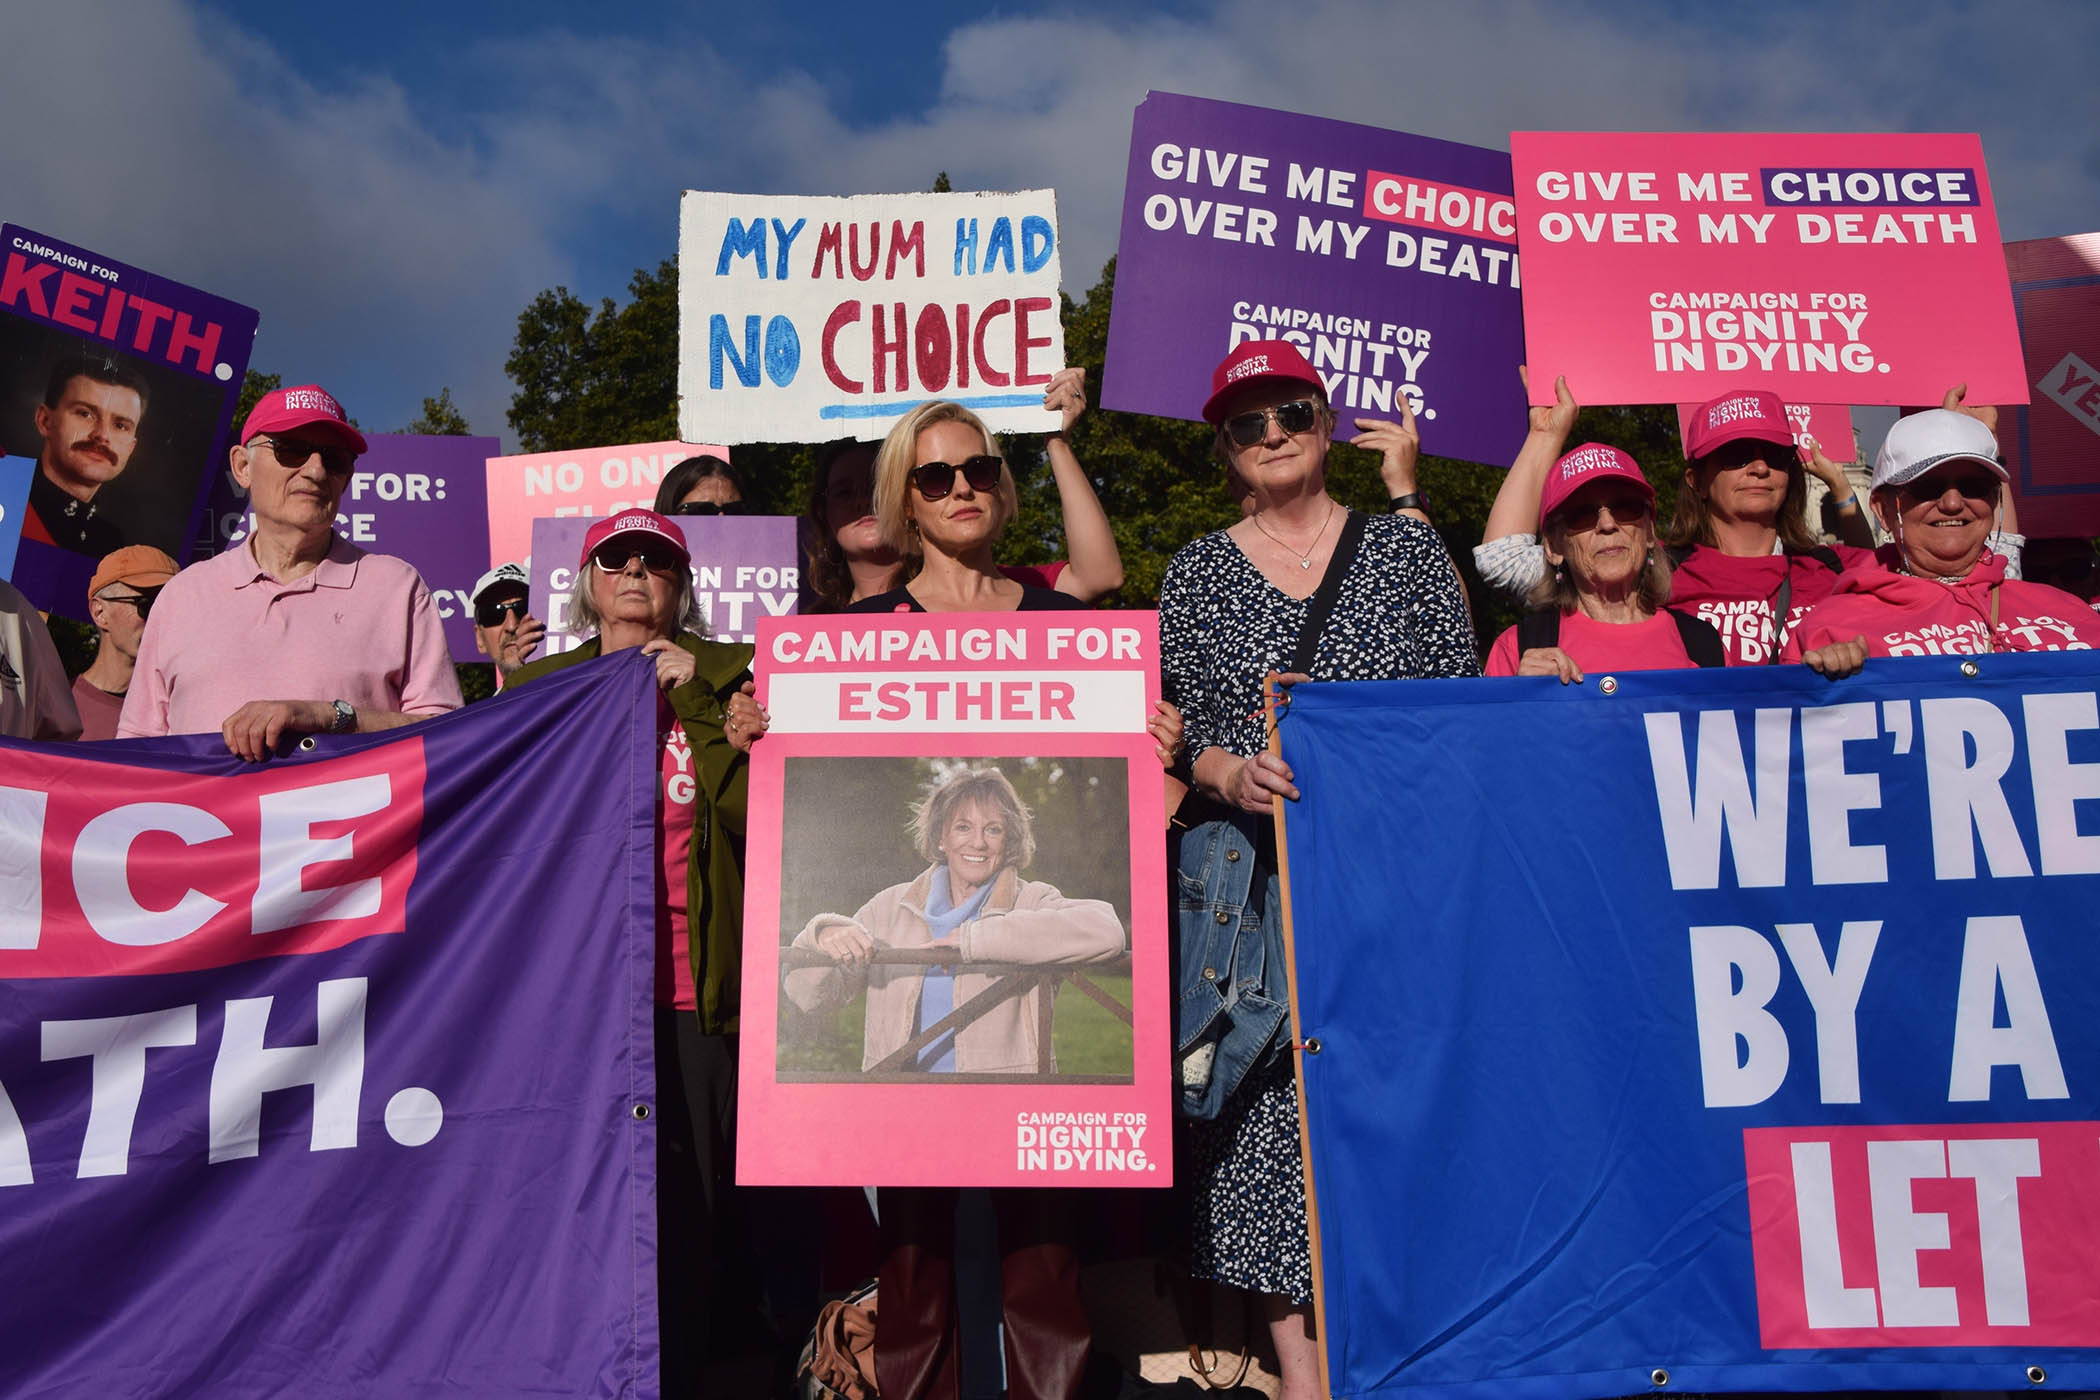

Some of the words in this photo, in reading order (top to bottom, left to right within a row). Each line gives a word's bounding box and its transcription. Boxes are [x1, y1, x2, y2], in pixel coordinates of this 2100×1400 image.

[1150, 142, 1270, 195] GIVE
[1286, 162, 1357, 209] ME
[1373, 178, 1517, 237] CHOIC
[1536, 171, 1659, 201] GIVE
[1677, 172, 1753, 202] ME
[1770, 172, 1971, 202] CHOICE
[1143, 193, 1278, 248] OVER
[1295, 215, 1372, 260] MY
[1538, 212, 1680, 243] OVER
[1698, 213, 1776, 244] MY
[1796, 213, 1977, 244] DEATH
[13, 237, 88, 272] CAMPAIGN
[91, 263, 119, 283] FOR
[715, 217, 807, 281] MY
[811, 219, 926, 282] MUM
[953, 215, 1055, 276] HAD
[0, 251, 234, 381] KEITH.
[1649, 292, 1799, 310] CAMPAIGN
[1810, 293, 1868, 310] FOR
[1232, 300, 1371, 340] CAMPAIGN
[1380, 322, 1432, 349] FOR
[1650, 310, 1869, 341] DIGNITY
[709, 314, 801, 390] NO
[821, 297, 1053, 395] CHOICE
[1653, 342, 1706, 372] IN
[1714, 342, 1892, 374] DYING.
[1316, 370, 1437, 421] YING.
[2057, 363, 2100, 422] YE
[351, 472, 447, 501] FOR:
[525, 461, 585, 497] NO
[736, 566, 800, 590] FOR
[772, 628, 1027, 663] CAMPAIGN
[1047, 628, 1142, 661] FOR
[838, 681, 1076, 721] ESTHER
[1643, 692, 2100, 891] WE'RE
[1688, 920, 1884, 1108] BY
[1947, 915, 2071, 1102] A
[1017, 1112, 1107, 1125] CAMPAIGN
[1113, 1112, 1147, 1125] FOR
[1017, 1126, 1147, 1148] DIGNITY
[1017, 1149, 1047, 1171] IN
[1053, 1149, 1156, 1171] DYING.
[1790, 1138, 2042, 1329] LET
